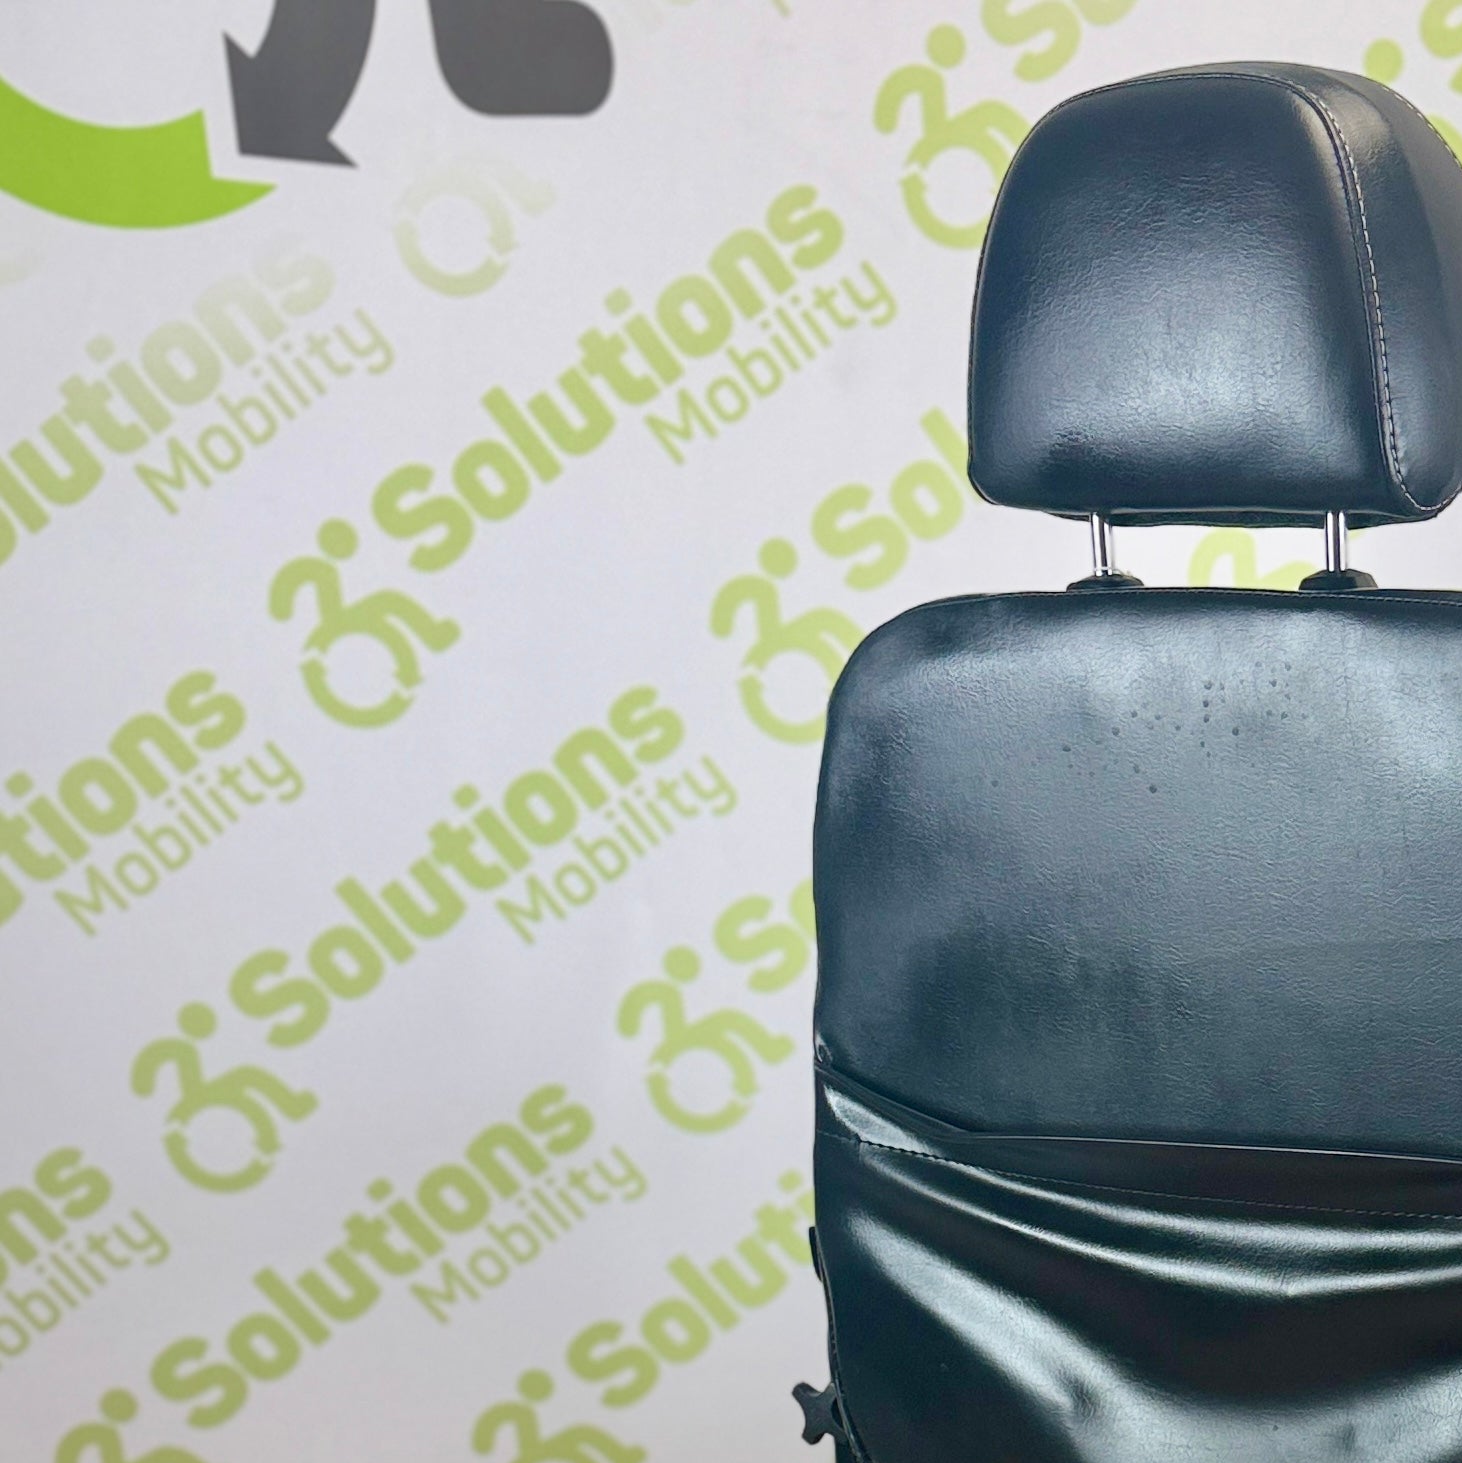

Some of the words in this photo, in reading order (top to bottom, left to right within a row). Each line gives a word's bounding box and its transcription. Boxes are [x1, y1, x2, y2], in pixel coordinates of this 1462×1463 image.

[134, 309, 395, 516] Mobility
[371, 184, 845, 574] Solutions
[642, 261, 900, 465] Mobility
[54, 741, 305, 937] Mobility
[228, 684, 686, 1048] Solutions
[494, 755, 740, 944] Mobility
[149, 1083, 595, 1429] Solutions
[409, 1146, 648, 1324] Mobility
